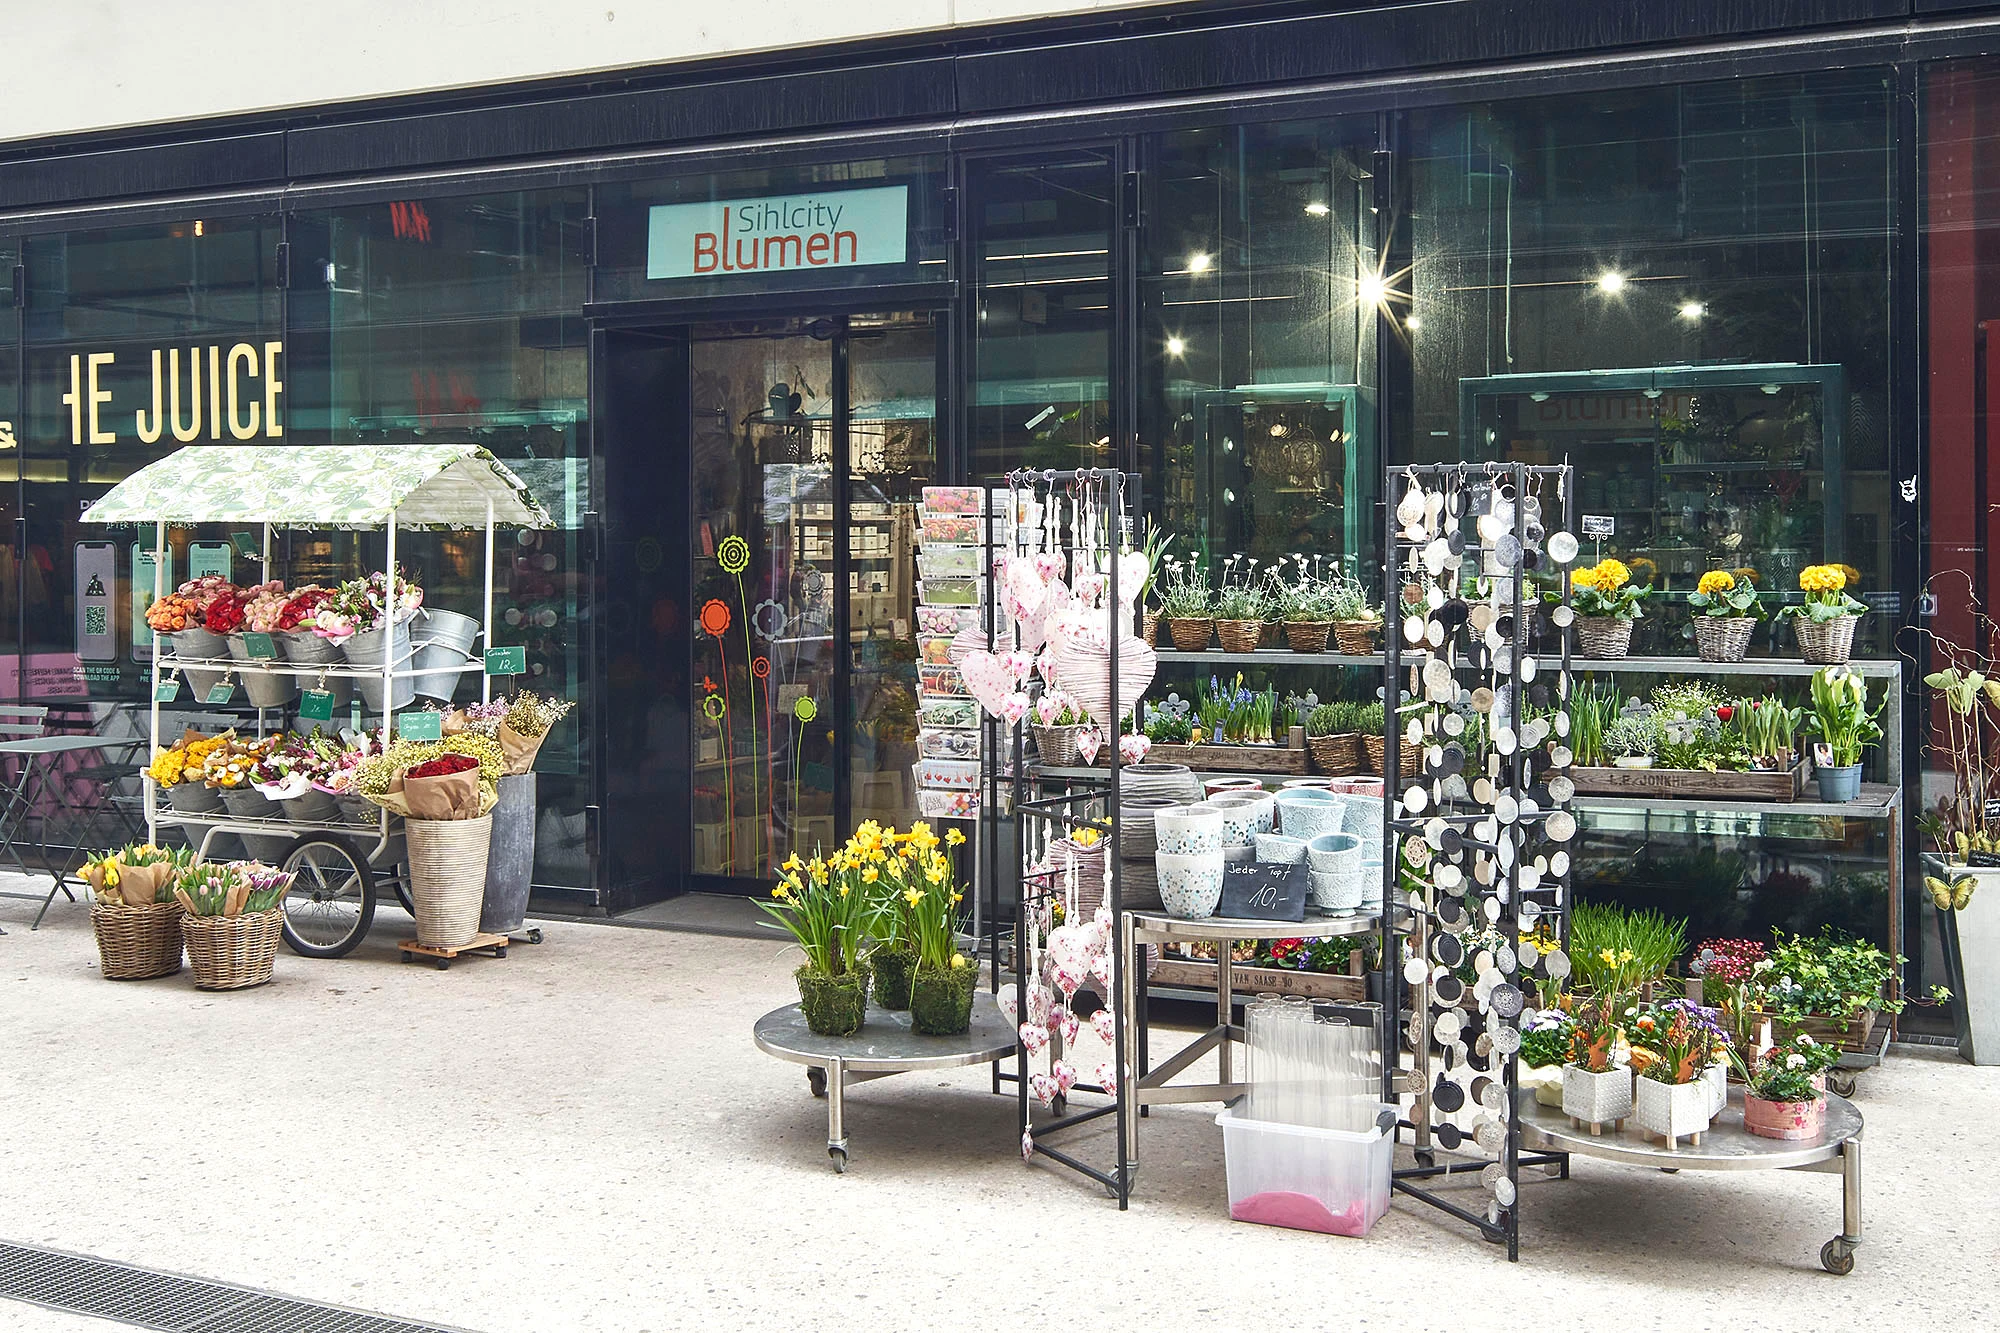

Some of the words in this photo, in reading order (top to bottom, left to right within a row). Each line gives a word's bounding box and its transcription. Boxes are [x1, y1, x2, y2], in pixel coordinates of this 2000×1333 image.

[739, 200, 843, 234] Sihlcity
[694, 207, 858, 273] Blumen
[136, 341, 283, 444] JUICE
[1228, 862, 1258, 874] Jeder
[1267, 864, 1292, 880] Topf
[1234, 973, 1249, 984] VAN
